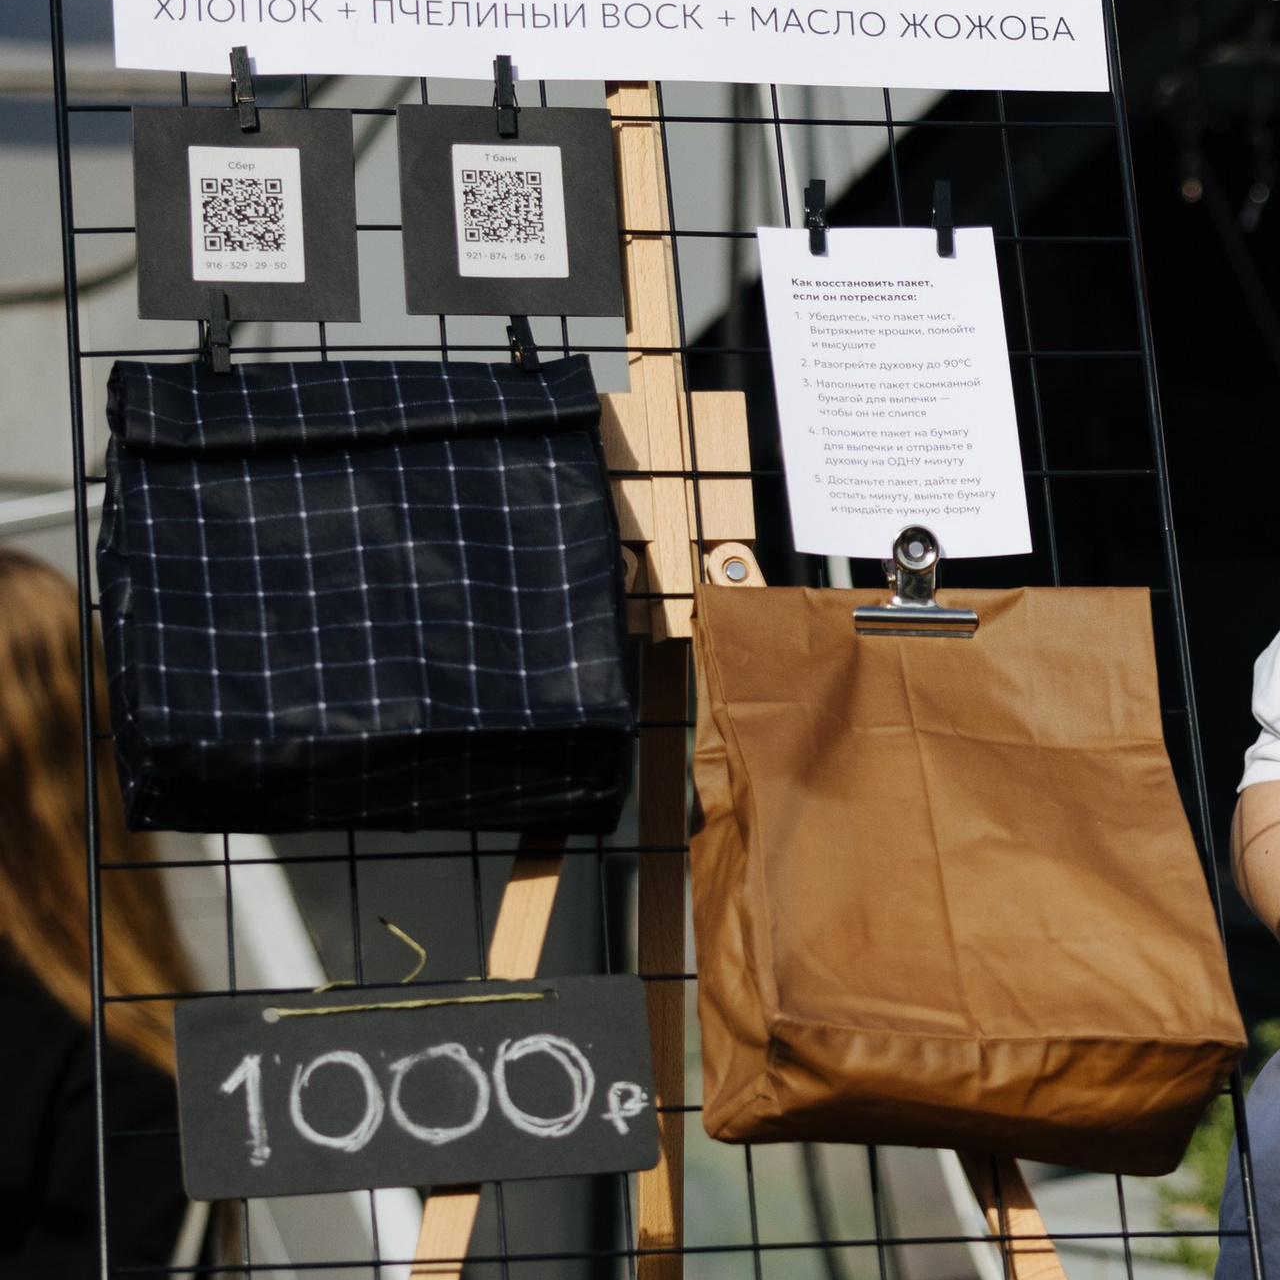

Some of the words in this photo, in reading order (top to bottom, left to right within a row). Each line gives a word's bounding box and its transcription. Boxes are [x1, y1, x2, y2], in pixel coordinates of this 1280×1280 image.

[602, 3, 703, 29] ВОСК
[751, 7, 886, 37] МАСЛО
[900, 13, 1075, 41] ЖОЖОБА
[493, 154, 517, 162] банк
[228, 162, 255, 171] Сбер
[490, 252, 507, 260] 874
[515, 253, 526, 261] 56
[534, 253, 545, 261] 76
[206, 261, 222, 269] 916
[274, 262, 287, 270] 50
[791, 277, 813, 288] Как
[816, 280, 894, 288] восстановить
[897, 280, 933, 289] пакет,
[793, 293, 819, 301] если
[823, 294, 837, 302] он
[840, 294, 917, 304] потрескался:
[795, 311, 802, 320] 1.
[808, 312, 870, 323] Убедитесь,
[872, 314, 891, 322] что
[893, 312, 925, 324] пакет
[926, 313, 955, 321] чист.
[810, 325, 876, 337] Вытряхните
[878, 327, 925, 337] крошки,
[927, 325, 975, 334] помойте
[821, 340, 876, 352] высушите
[801, 358, 810, 368] 2.
[814, 359, 877, 371] Разогрейте
[879, 362, 924, 372] духовку
[926, 362, 941, 370] до
[803, 378, 812, 387] 3.
[816, 379, 877, 390] Наполните
[879, 382, 910, 390] пакет
[913, 378, 980, 389] скомканной
[818, 393, 863, 404] бумагой
[866, 397, 886, 405] для
[889, 395, 936, 404] выпечки
[819, 408, 853, 417] чтобы
[854, 409, 869, 417] он
[872, 410, 885, 418] не
[888, 410, 926, 418] слипся
[808, 426, 818, 435] 4.
[822, 426, 877, 438] Положите
[880, 431, 911, 439] пакет
[930, 428, 968, 439] бумагу
[824, 443, 844, 451] для
[846, 444, 894, 452] выпечки
[905, 443, 964, 453] отправьте
[825, 457, 869, 468] духовку
[871, 459, 885, 467] на
[886, 456, 921, 468] ОДНУ
[924, 458, 964, 467] минуту
[815, 474, 824, 483] 5.
[826, 475, 885, 486] Достаньте
[888, 478, 922, 487] пакет,
[924, 476, 957, 487] дайте
[960, 477, 981, 486] ему
[829, 491, 866, 500] остыть
[869, 493, 912, 504] минуту,
[914, 492, 954, 500] выньте
[957, 490, 996, 501] бумагу
[841, 505, 893, 515] придайте
[896, 507, 941, 517] нужную
[943, 505, 981, 515] форму
